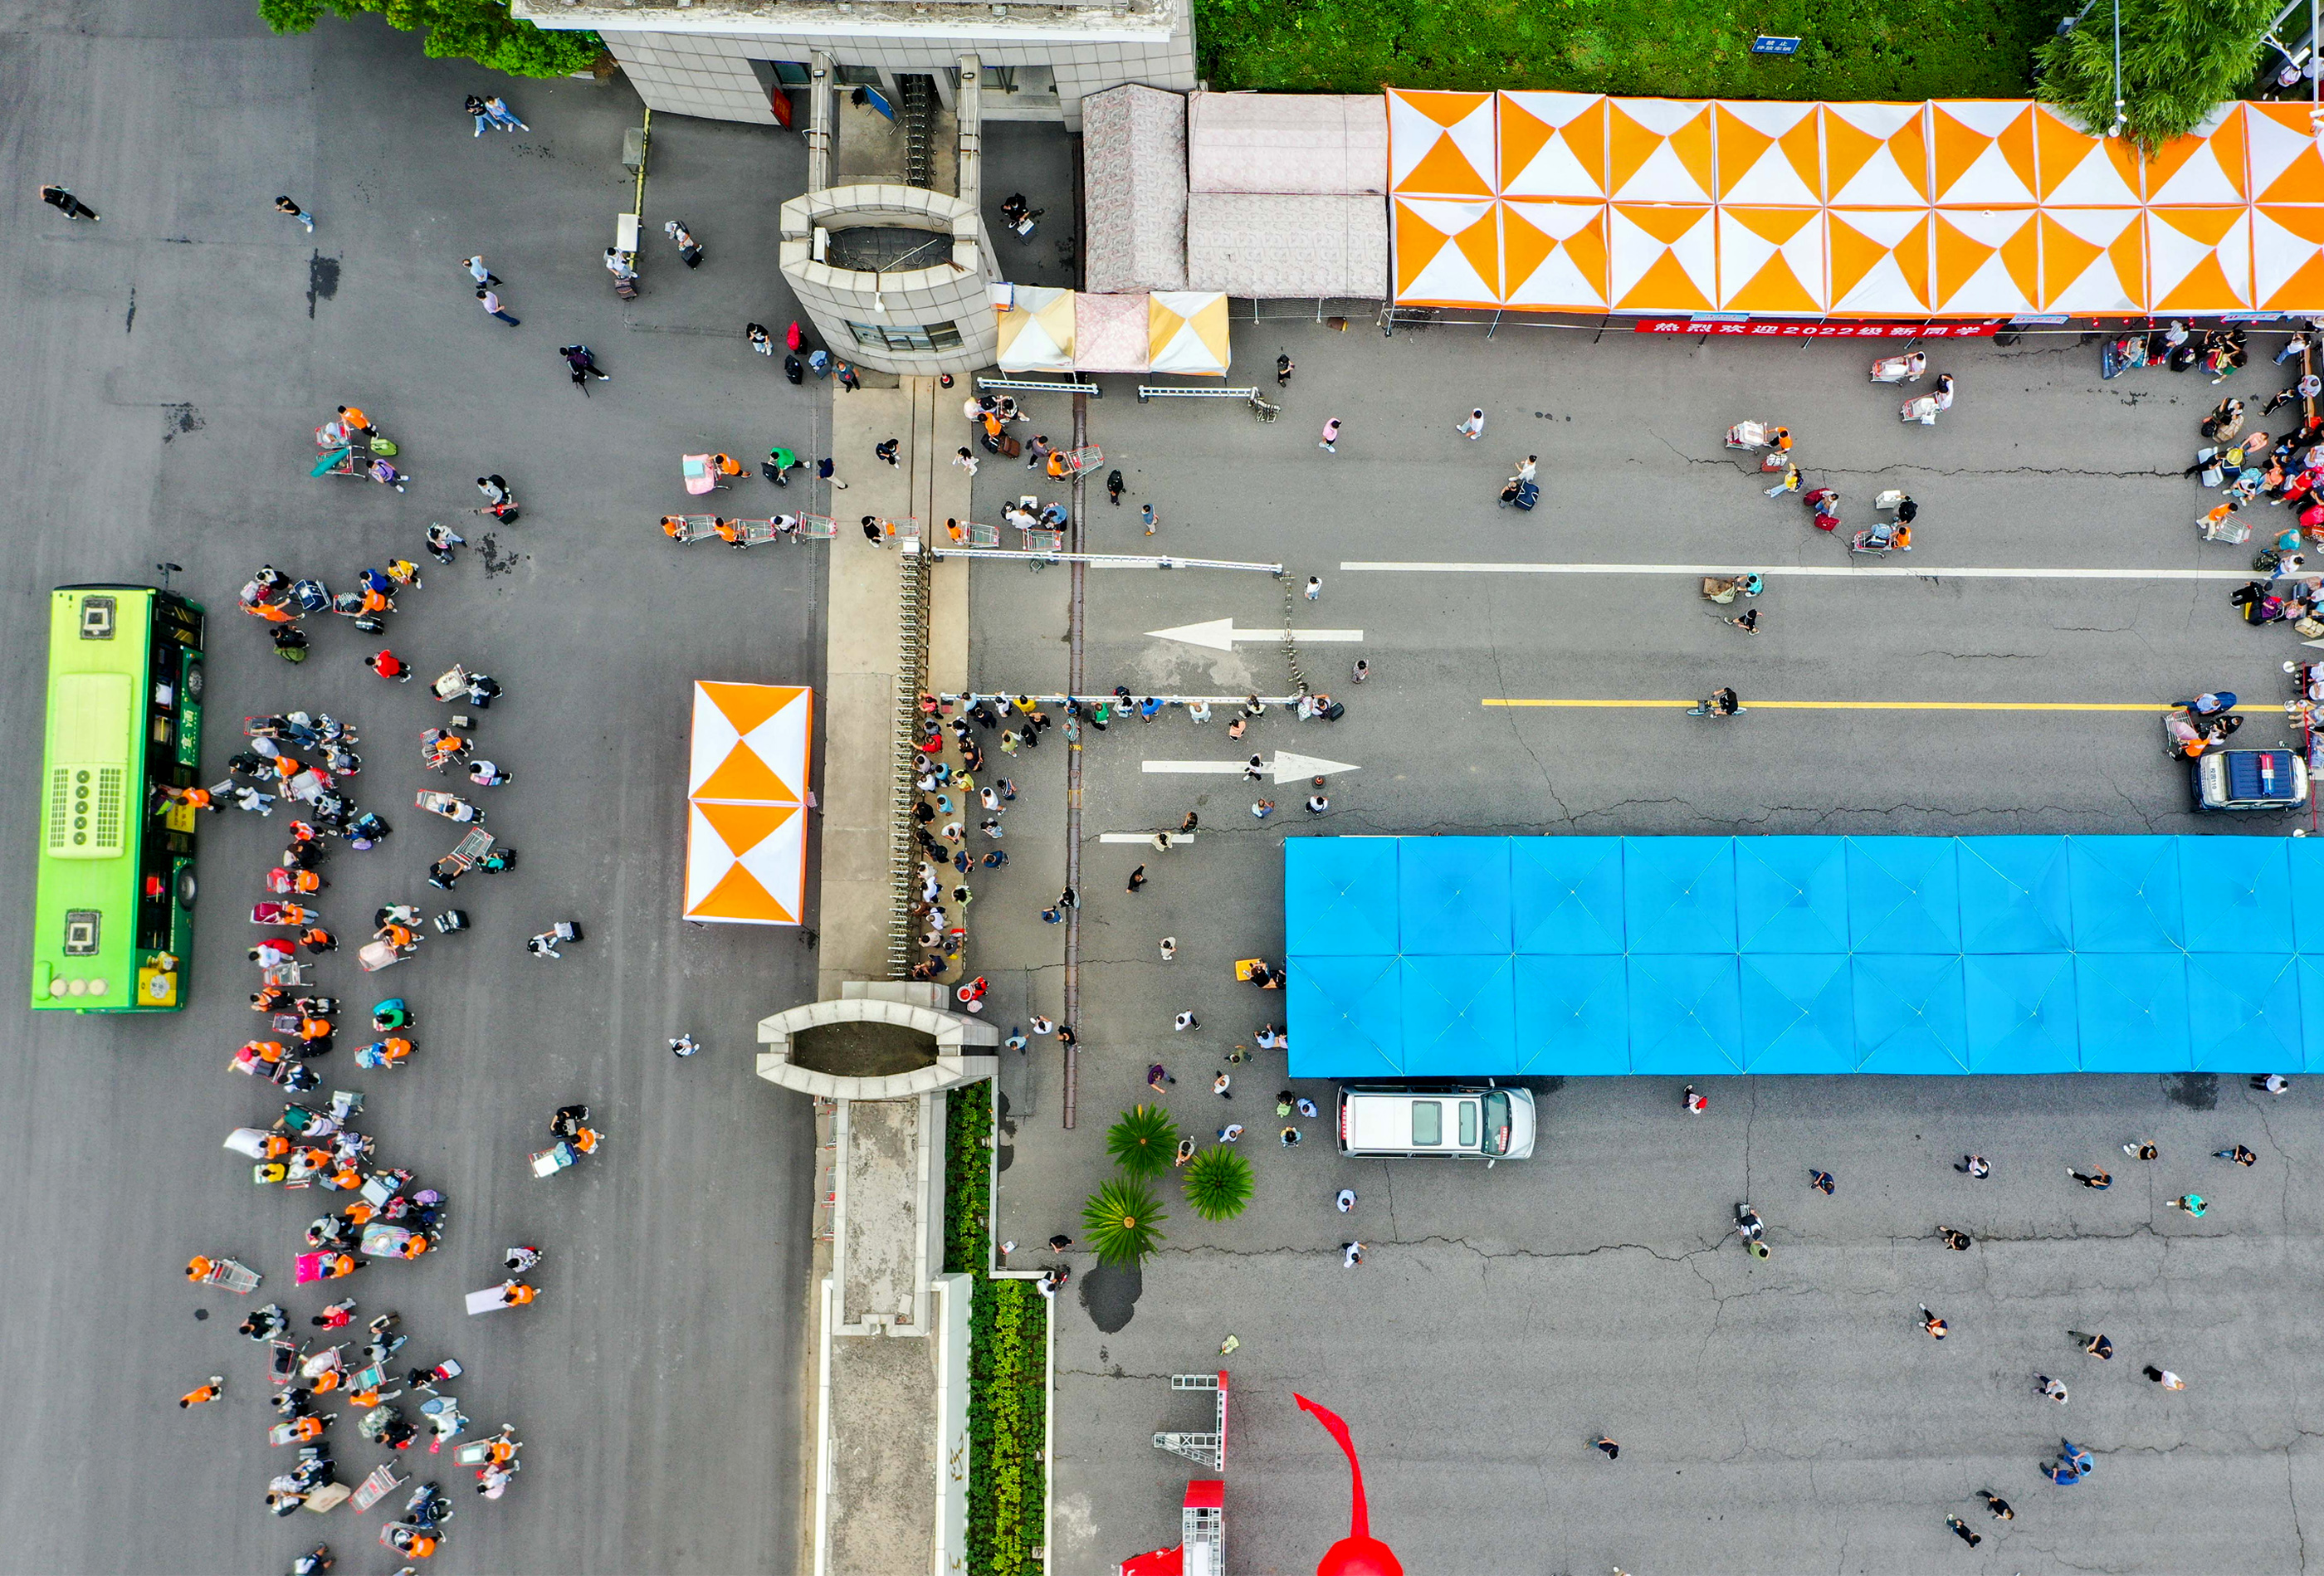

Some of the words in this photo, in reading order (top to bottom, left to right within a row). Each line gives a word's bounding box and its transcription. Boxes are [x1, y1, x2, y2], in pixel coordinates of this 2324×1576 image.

[1653, 322, 1981, 336] 热烈欢迎2022级新同学
